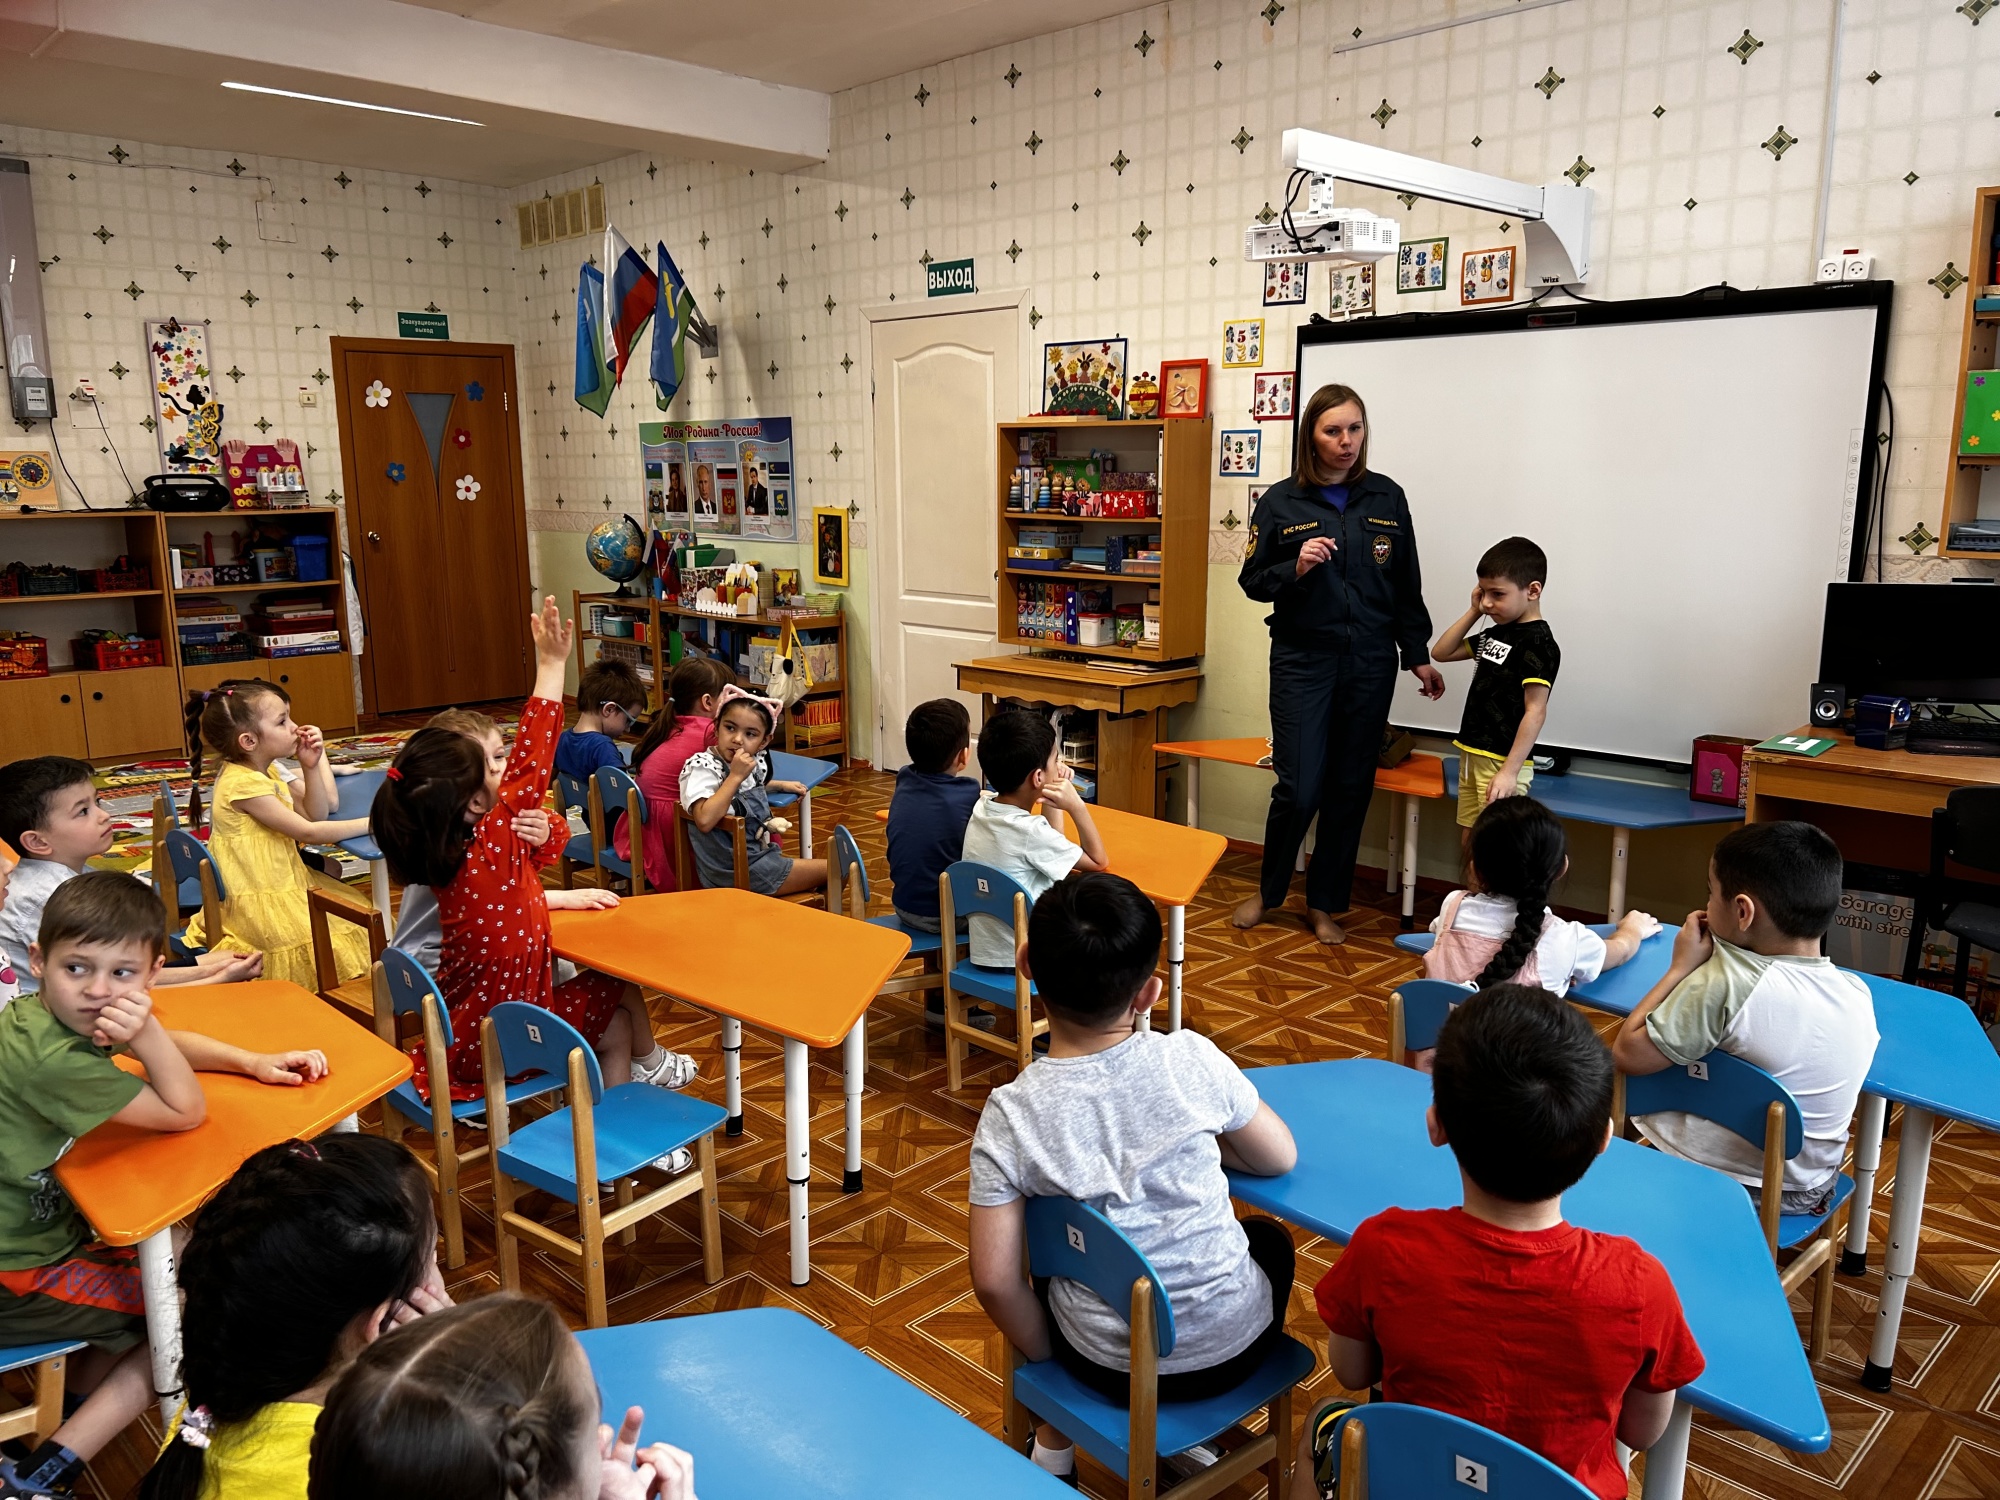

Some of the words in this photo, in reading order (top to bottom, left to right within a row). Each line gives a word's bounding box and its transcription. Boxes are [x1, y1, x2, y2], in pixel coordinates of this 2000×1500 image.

[1415, 251, 1427, 267] 8
[929, 267, 972, 289] ВЫХОД
[1280, 269, 1291, 283] 6
[1345, 275, 1356, 290] 7
[1480, 268, 1492, 283] 9
[401, 318, 446, 326] Эвакуационный
[1237, 330, 1246, 343] 5
[1268, 383, 1279, 398] 4
[663, 425, 684, 439] Моя
[685, 421, 762, 438] Родина-Россия!
[1235, 441, 1243, 453] 3
[288, 475, 295, 485] 3
[1295, 521, 1318, 531] РОССИИ
[980, 881, 986, 890] 2
[1838, 894, 1914, 921] Garage
[1835, 914, 1871, 931] with
[1876, 922, 1929, 941] stret
[530, 1028, 538, 1039] 2
[1693, 1064, 1702, 1076] 2
[1072, 1231, 1080, 1246] 2
[167, 1258, 174, 1274] 2
[1465, 1465, 1477, 1484] 2
